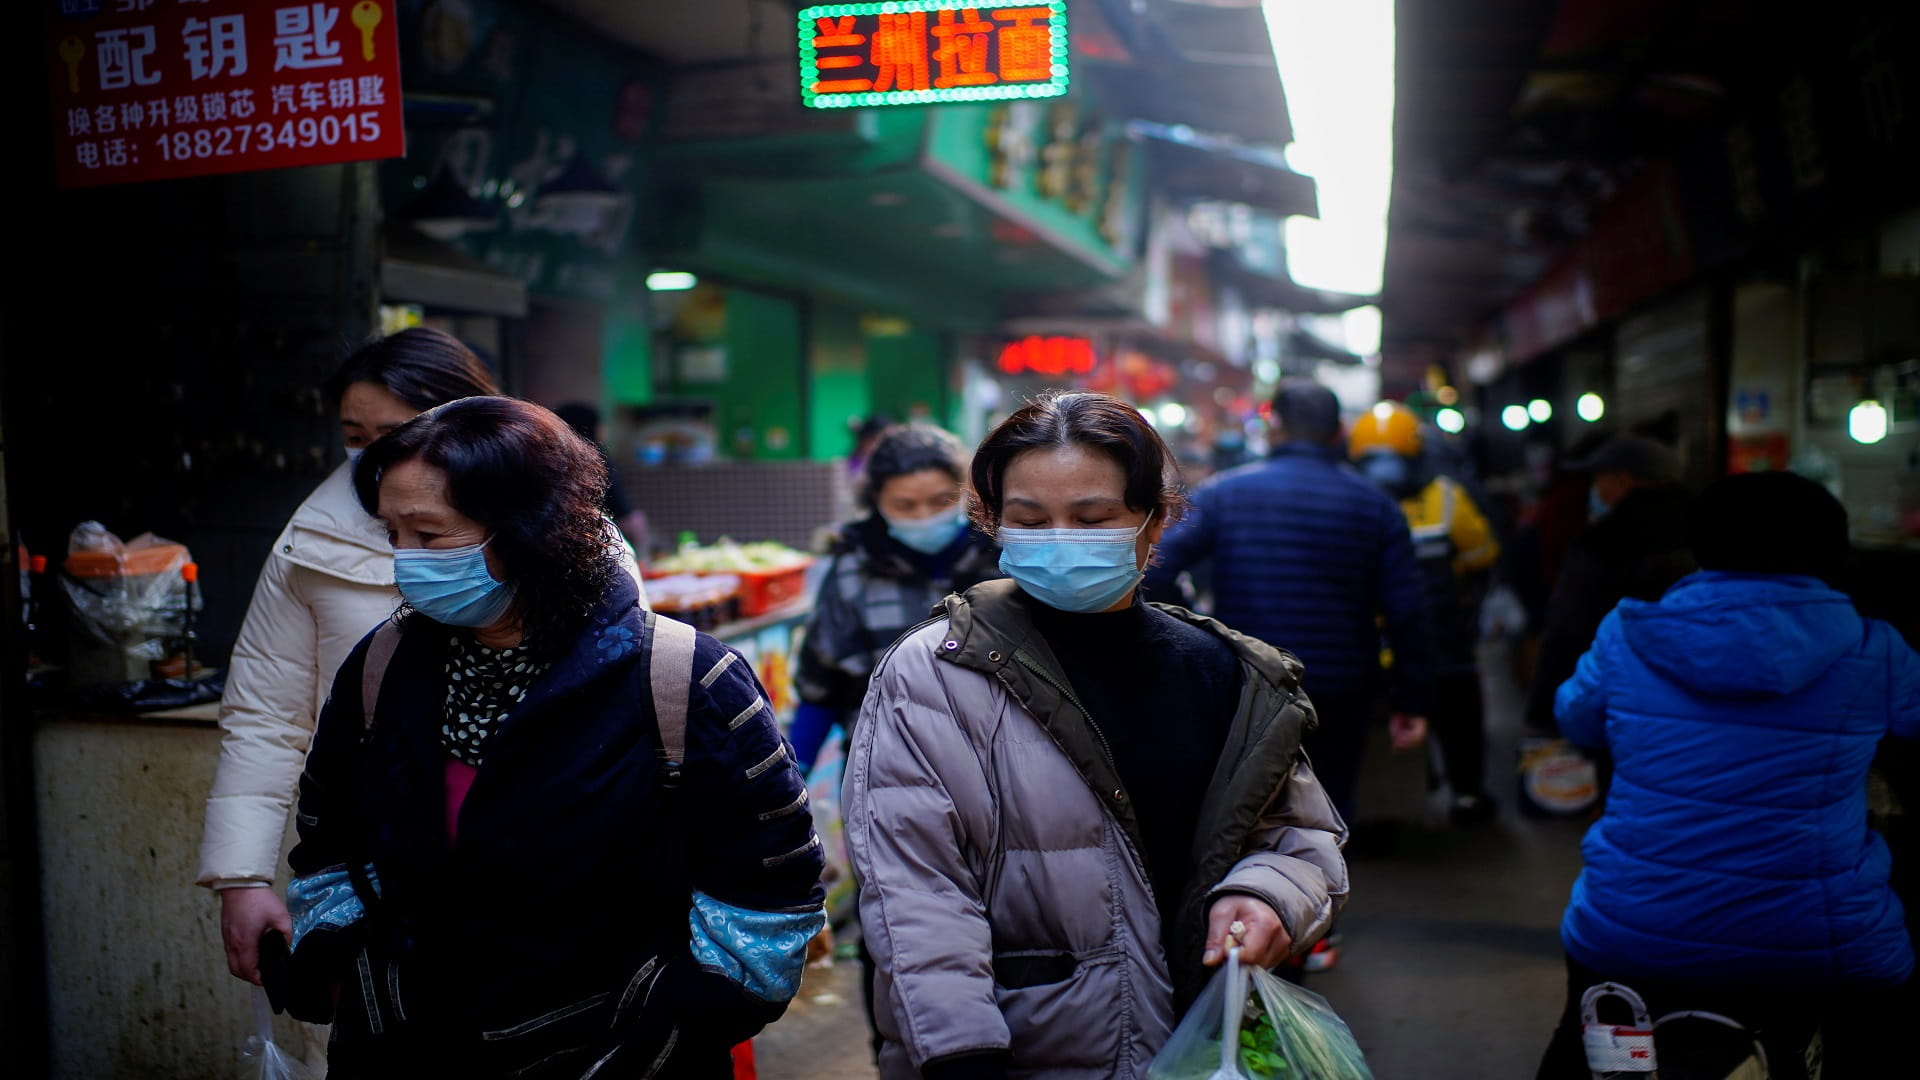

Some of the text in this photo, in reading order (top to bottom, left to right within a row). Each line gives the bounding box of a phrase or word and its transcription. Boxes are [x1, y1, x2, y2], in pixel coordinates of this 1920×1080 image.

[96, 4, 342, 90] 配钥匙
[811, 8, 1052, 92] 兰州拉面
[67, 75, 386, 136] 换各种升级锁芯 汽车钥匙
[155, 111, 382, 161] 18827349015
